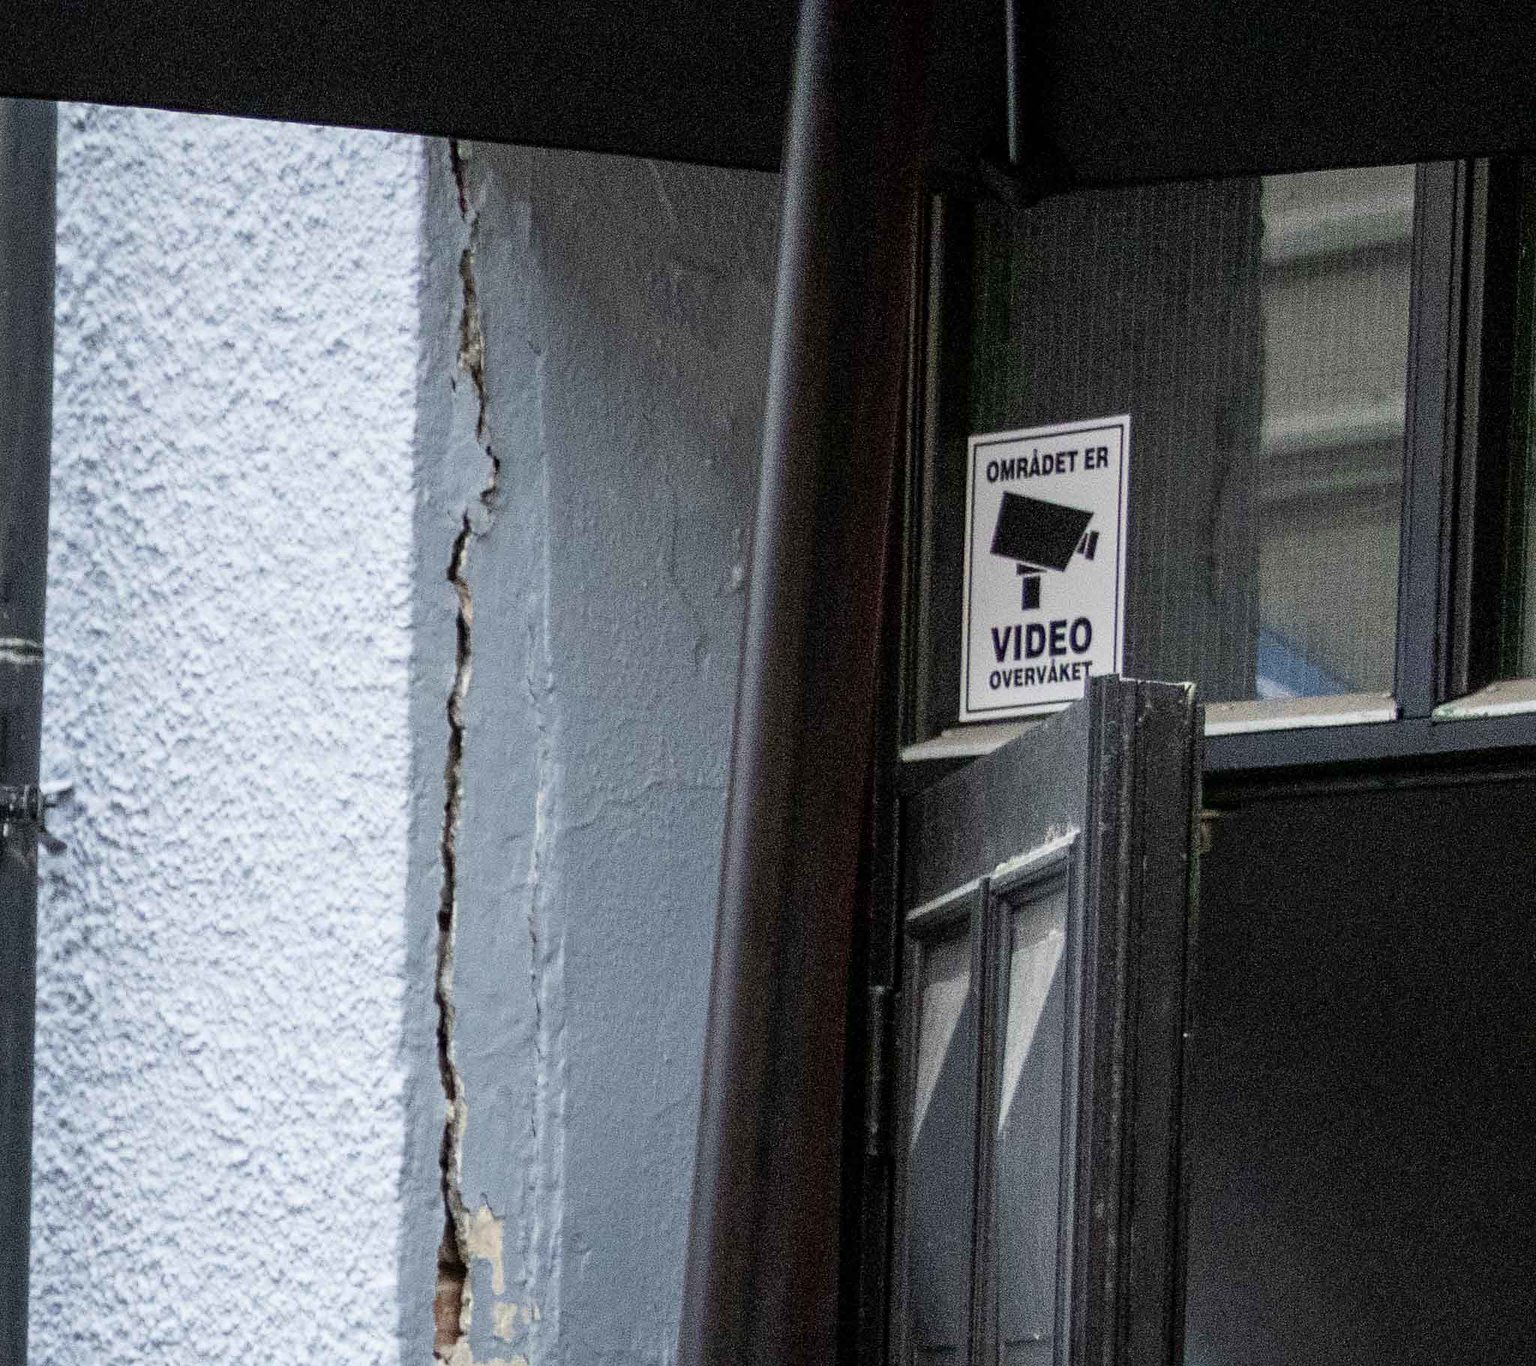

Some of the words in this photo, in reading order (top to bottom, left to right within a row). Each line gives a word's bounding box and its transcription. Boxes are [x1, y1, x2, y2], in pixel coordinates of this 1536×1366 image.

[987, 449, 1077, 483] OMRÅDET
[1084, 446, 1109, 471] ER
[991, 616, 1093, 663] VIDEO
[989, 659, 1093, 690] OVERVÅKET
